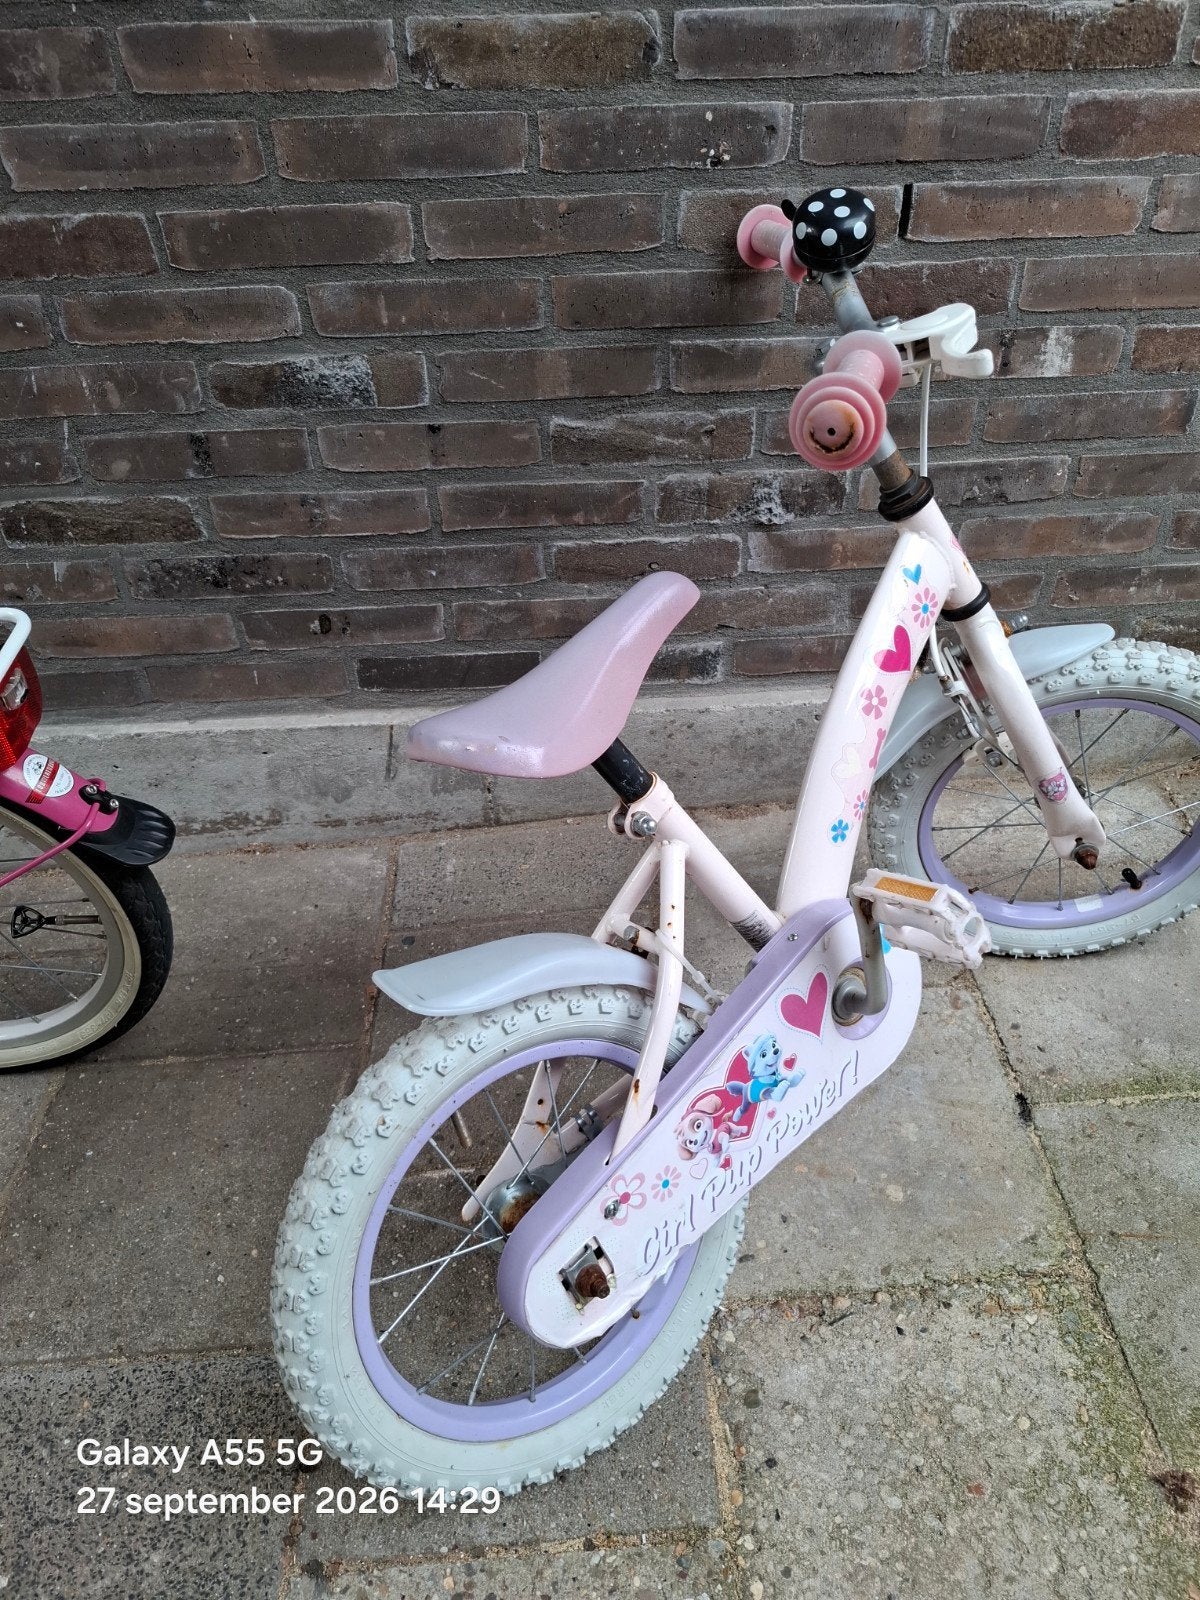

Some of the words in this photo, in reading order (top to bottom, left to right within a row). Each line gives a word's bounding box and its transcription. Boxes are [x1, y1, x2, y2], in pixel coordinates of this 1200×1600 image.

[640, 1193, 697, 1276] Girl
[700, 1145, 763, 1212] Pup
[766, 1049, 860, 1154] Power!
